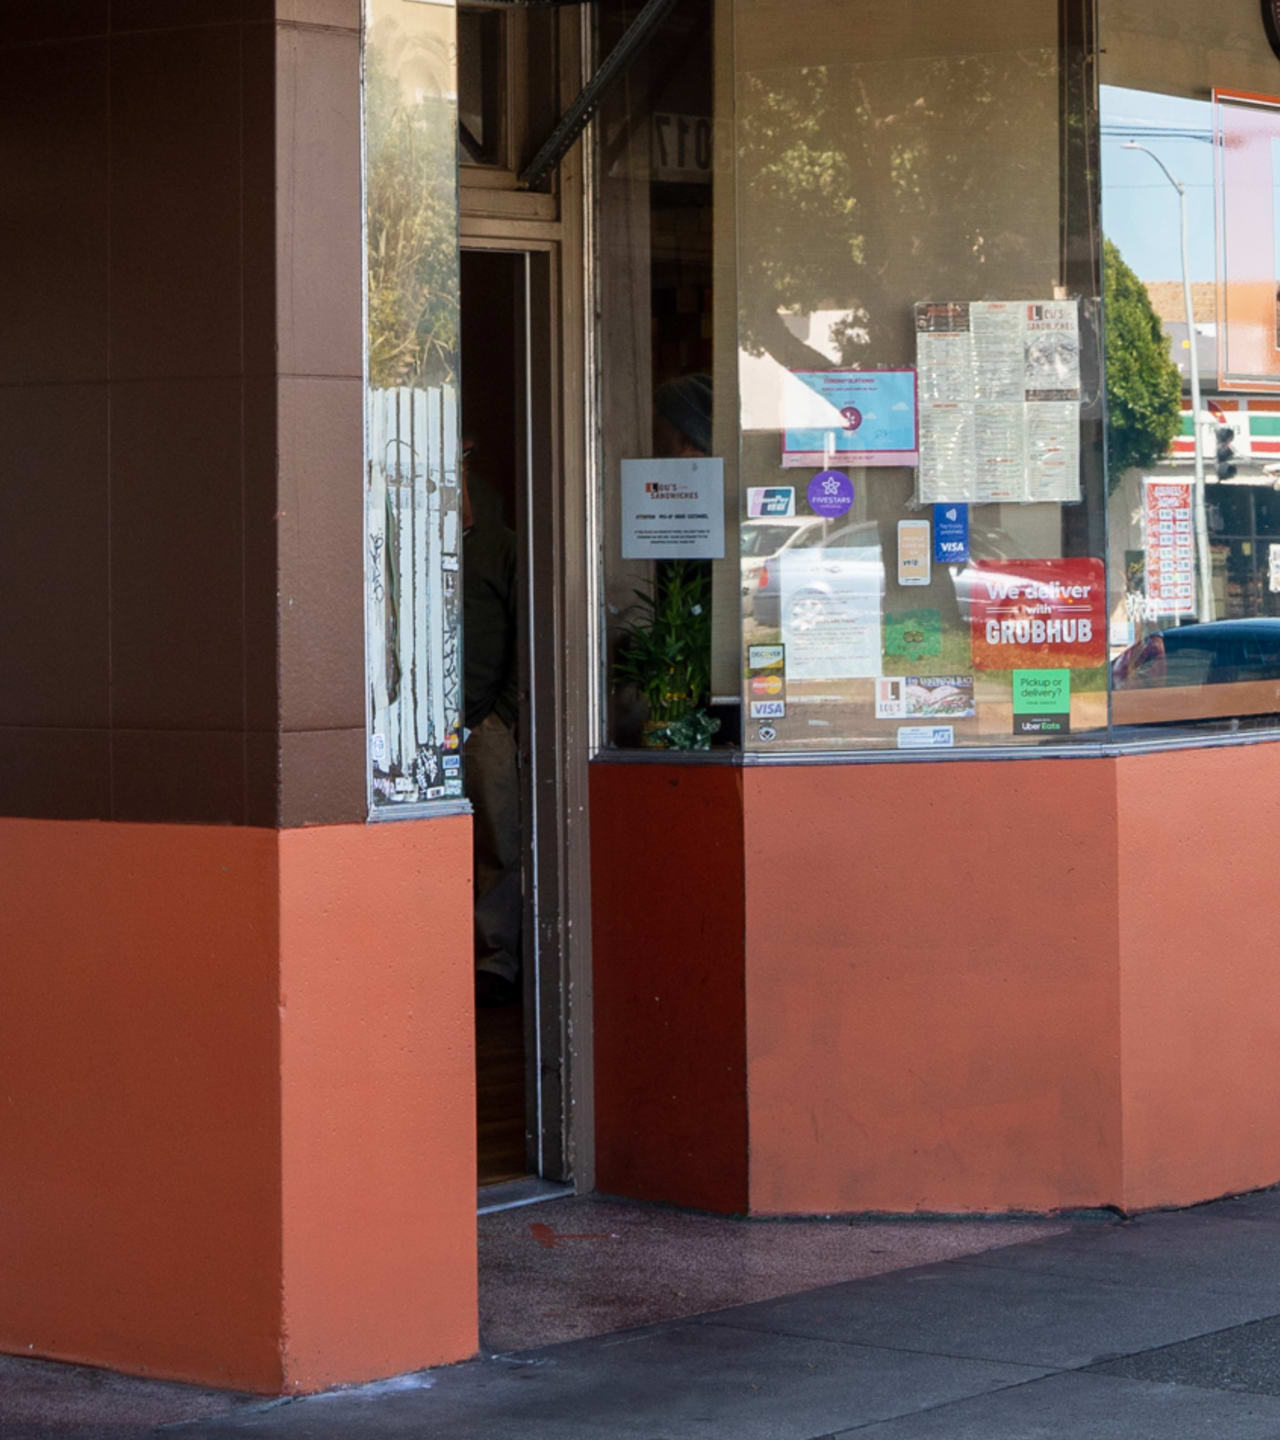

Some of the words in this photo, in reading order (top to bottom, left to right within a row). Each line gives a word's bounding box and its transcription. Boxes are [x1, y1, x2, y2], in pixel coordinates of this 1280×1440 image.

[812, 496, 851, 504] FIVESTARS
[940, 542, 964, 552] VISA
[986, 582, 1020, 600] We
[1024, 580, 1091, 599] deliver
[1026, 603, 1052, 614] with
[985, 619, 1093, 645] GRUBHUB
[1020, 678, 1051, 688] Pickup
[1021, 687, 1063, 699] delivery?
[753, 703, 783, 715] VISA
